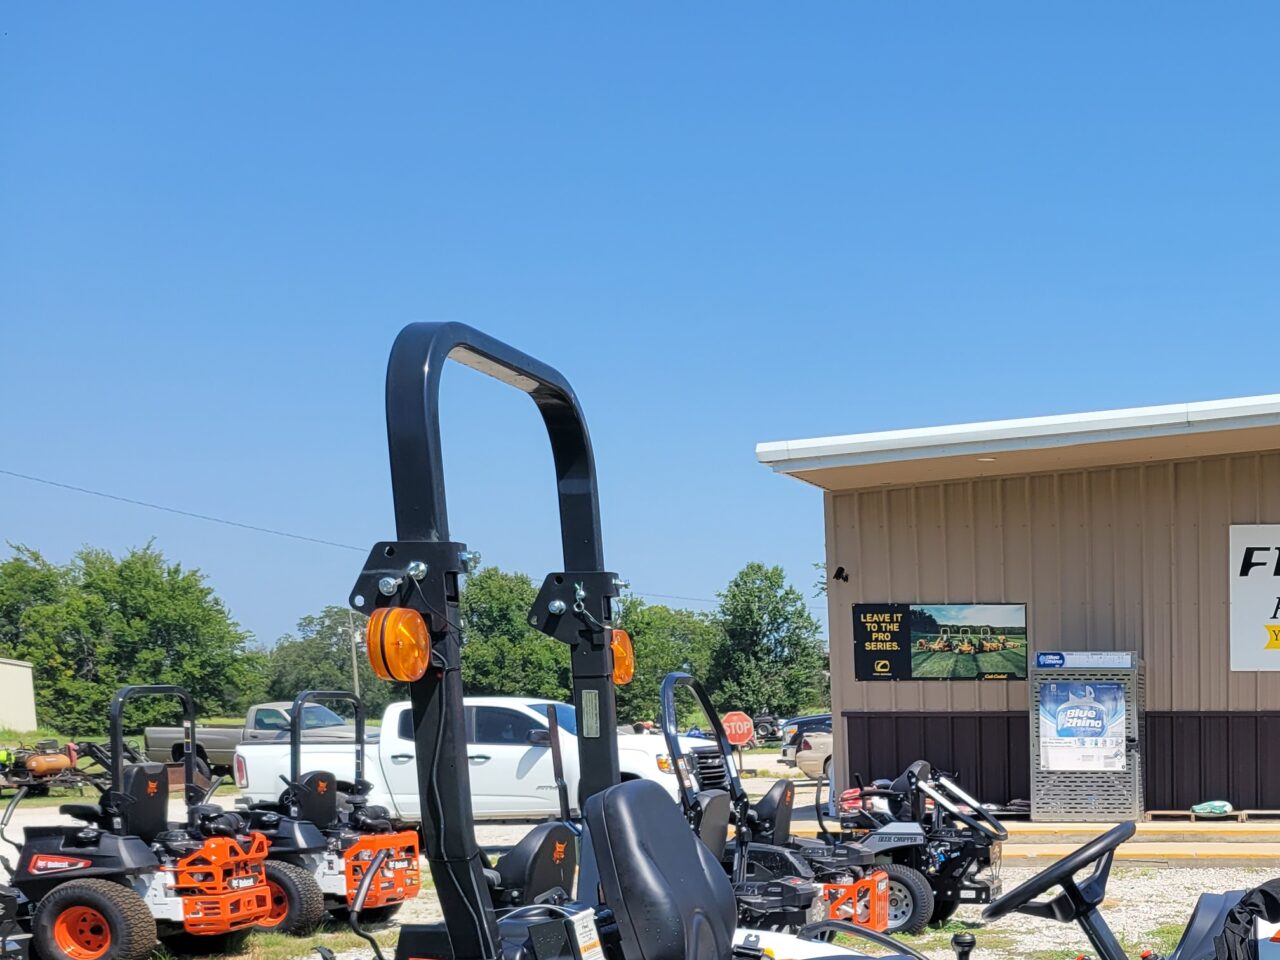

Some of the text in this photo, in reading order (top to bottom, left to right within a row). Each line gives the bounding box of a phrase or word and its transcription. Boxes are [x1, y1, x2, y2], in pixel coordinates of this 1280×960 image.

[860, 613, 902, 622] LEAVE IT
[866, 623, 899, 631] TO THE
[872, 633, 891, 641] PRO
[864, 642, 901, 650] SERIES.
[1066, 708, 1096, 718] Blue
[725, 721, 750, 735] STOP
